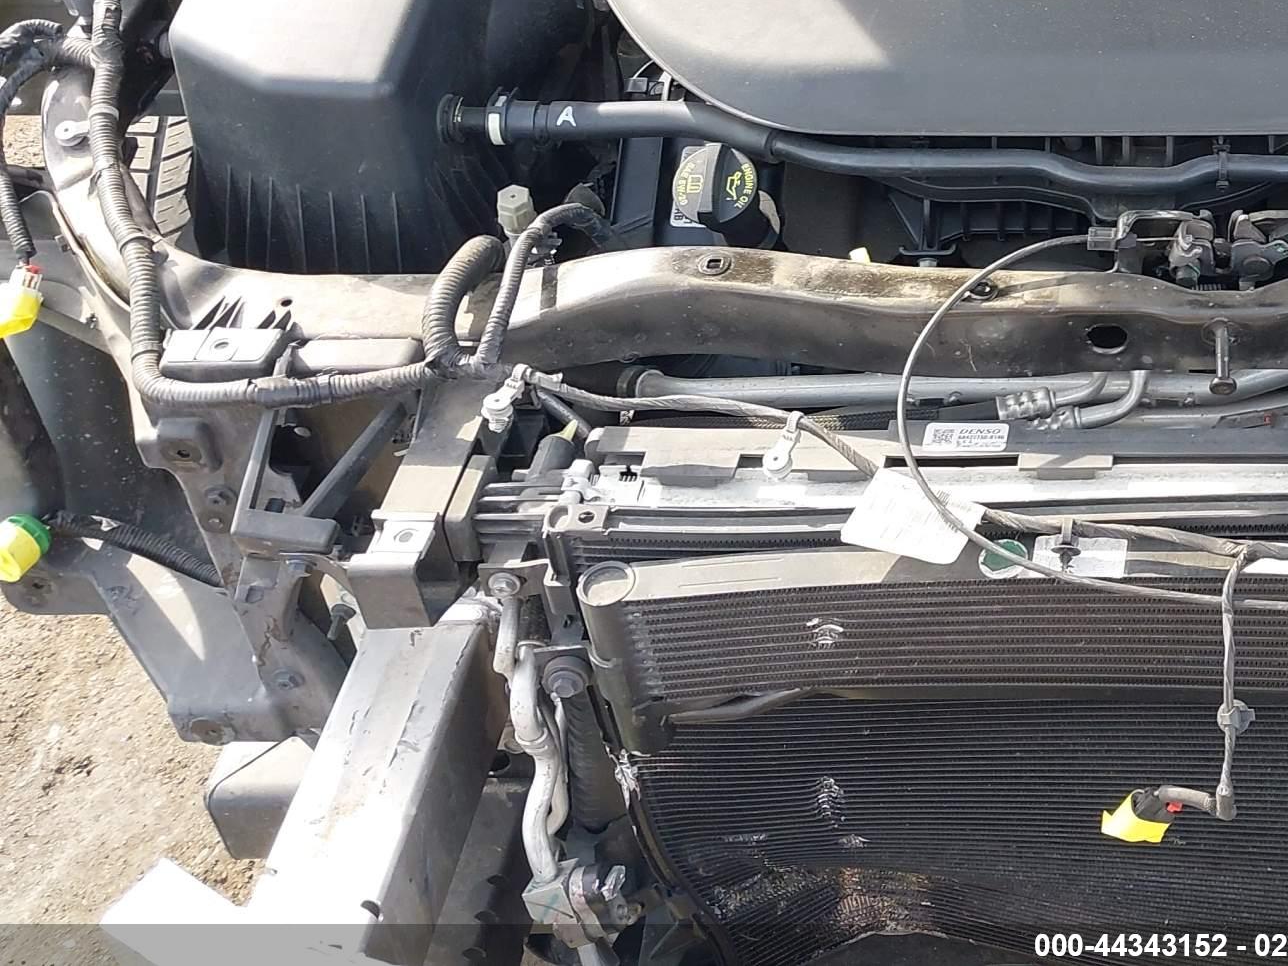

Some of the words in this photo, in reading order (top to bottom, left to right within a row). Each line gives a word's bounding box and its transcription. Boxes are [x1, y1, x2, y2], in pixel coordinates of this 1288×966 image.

[555, 105, 577, 127] A
[740, 163, 755, 195] ENGINE
[734, 195, 749, 209] OIL
